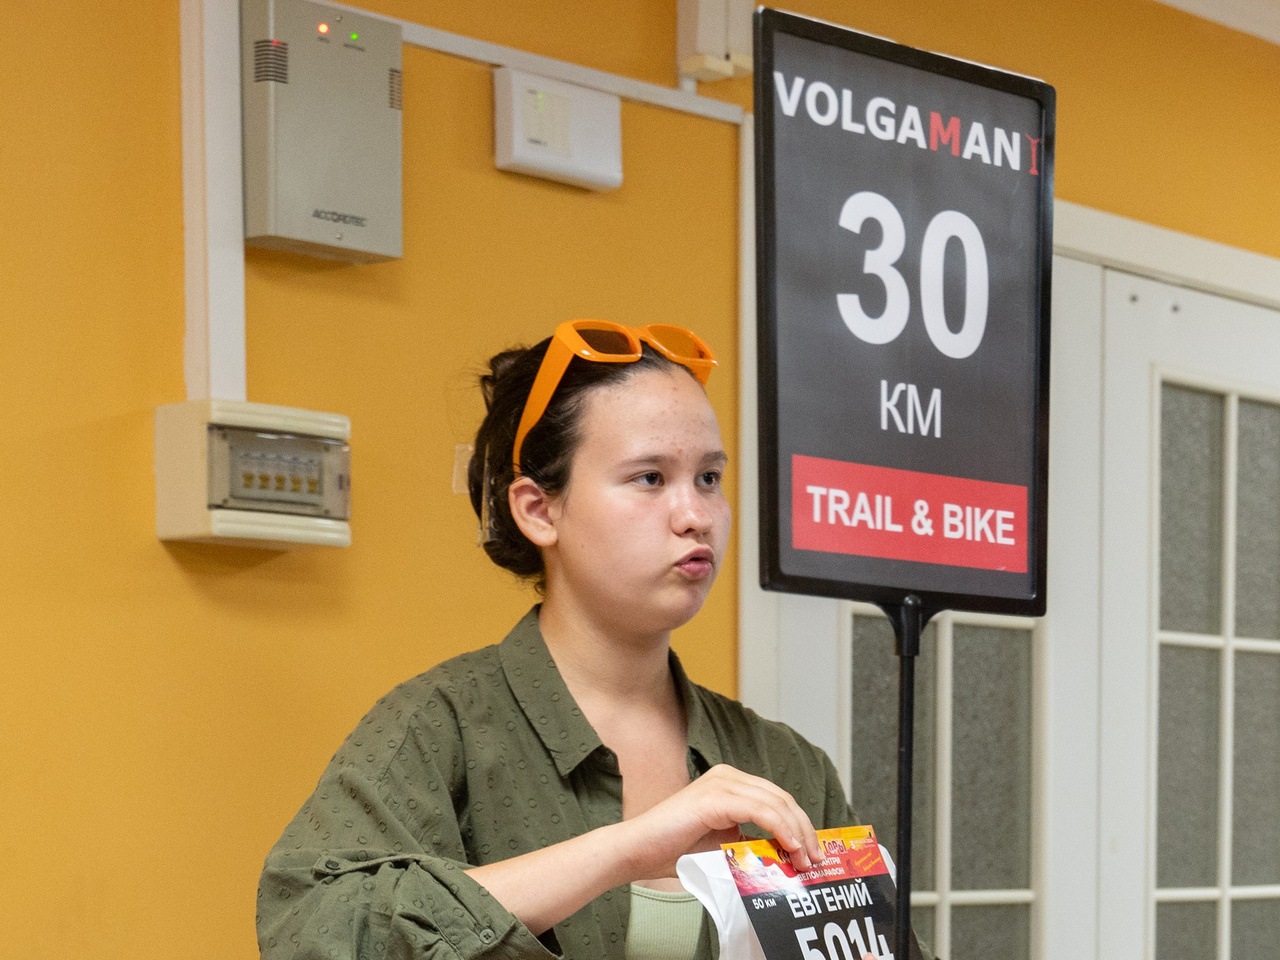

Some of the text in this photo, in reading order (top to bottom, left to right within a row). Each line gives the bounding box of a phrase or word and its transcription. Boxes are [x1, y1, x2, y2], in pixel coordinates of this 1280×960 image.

[773, 71, 1021, 171] VOLGAMAN
[836, 190, 990, 359] 30
[806, 485, 1016, 546] TRAIL & BIKE
[752, 897, 763, 910] 50
[786, 877, 874, 918] ЕВГЕНИЙ
